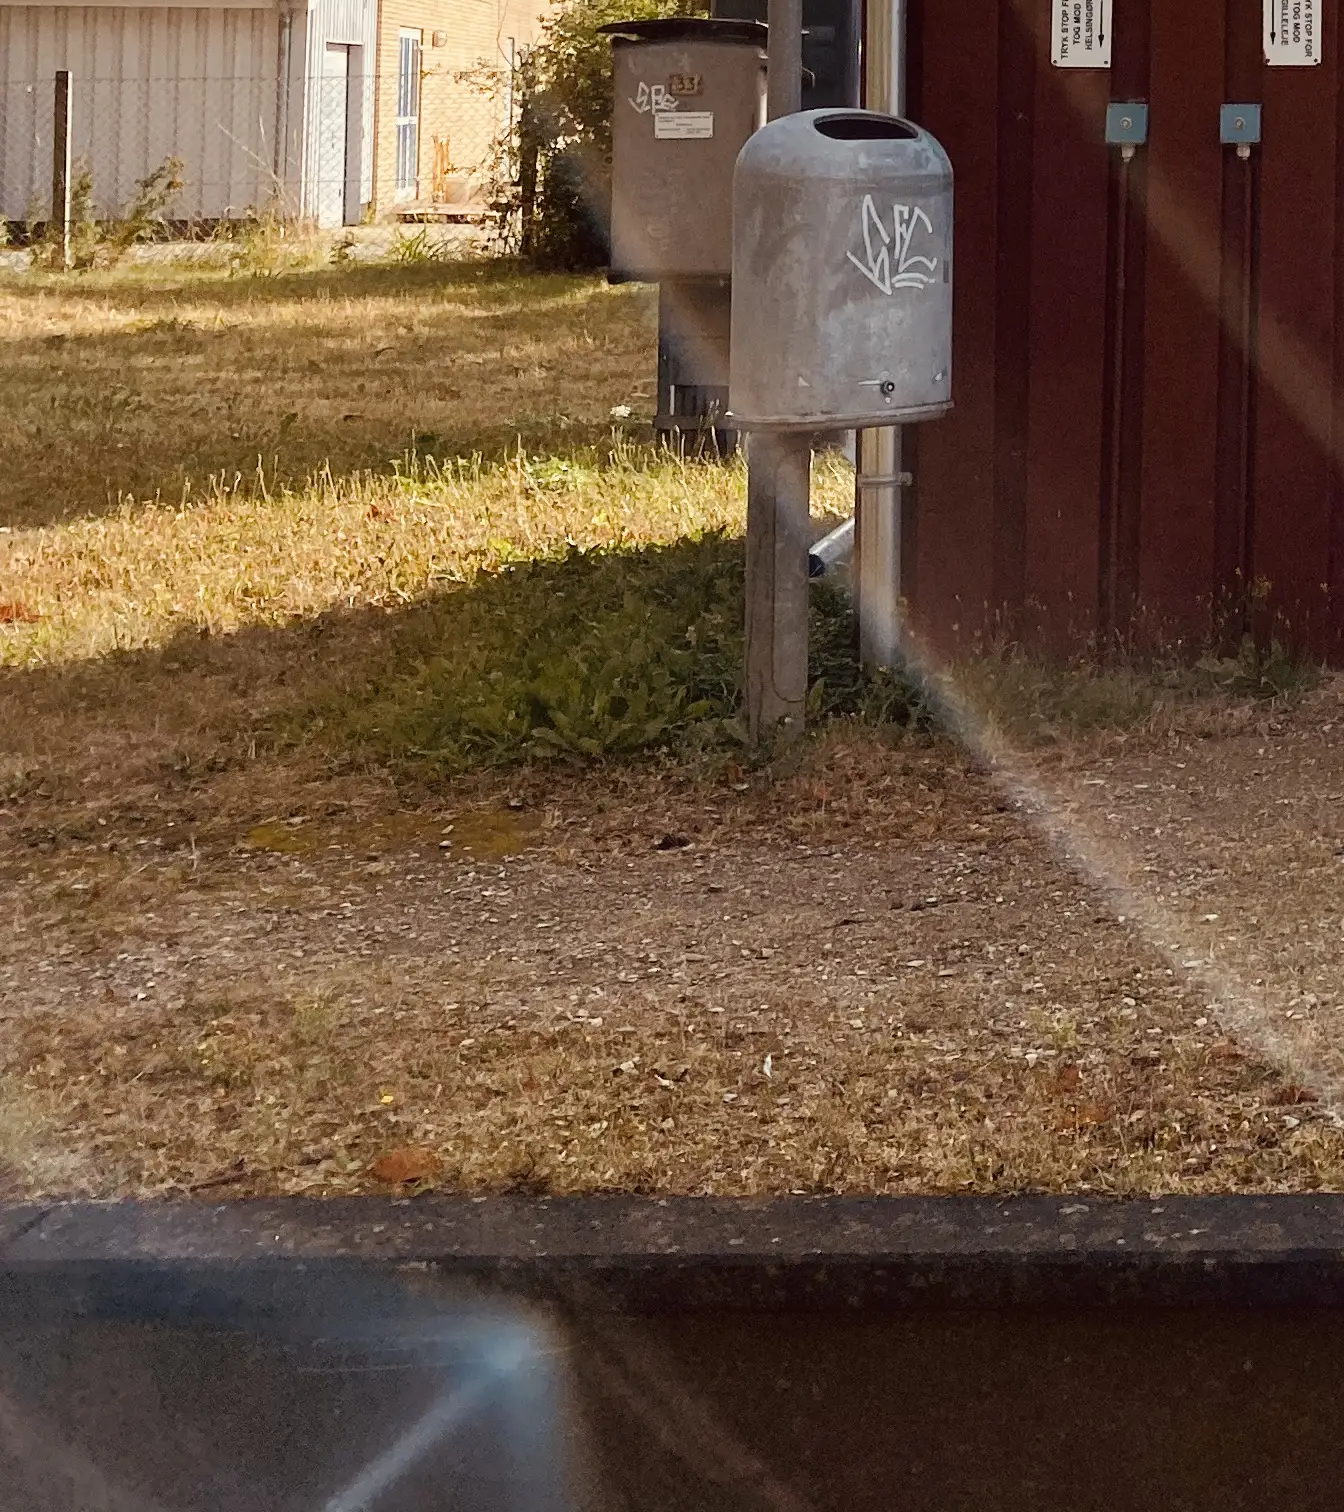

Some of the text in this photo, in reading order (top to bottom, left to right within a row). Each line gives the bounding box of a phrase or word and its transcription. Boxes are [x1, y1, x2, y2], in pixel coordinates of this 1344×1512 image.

[1061, 9, 1069, 33] STOP
[1073, 3, 1081, 45] TOG MOD
[1293, 1, 1301, 43] TOG MOD
[1305, 13, 1313, 36] STOP
[1061, 36, 1069, 60] TRYK
[1305, 39, 1313, 57] FOR
